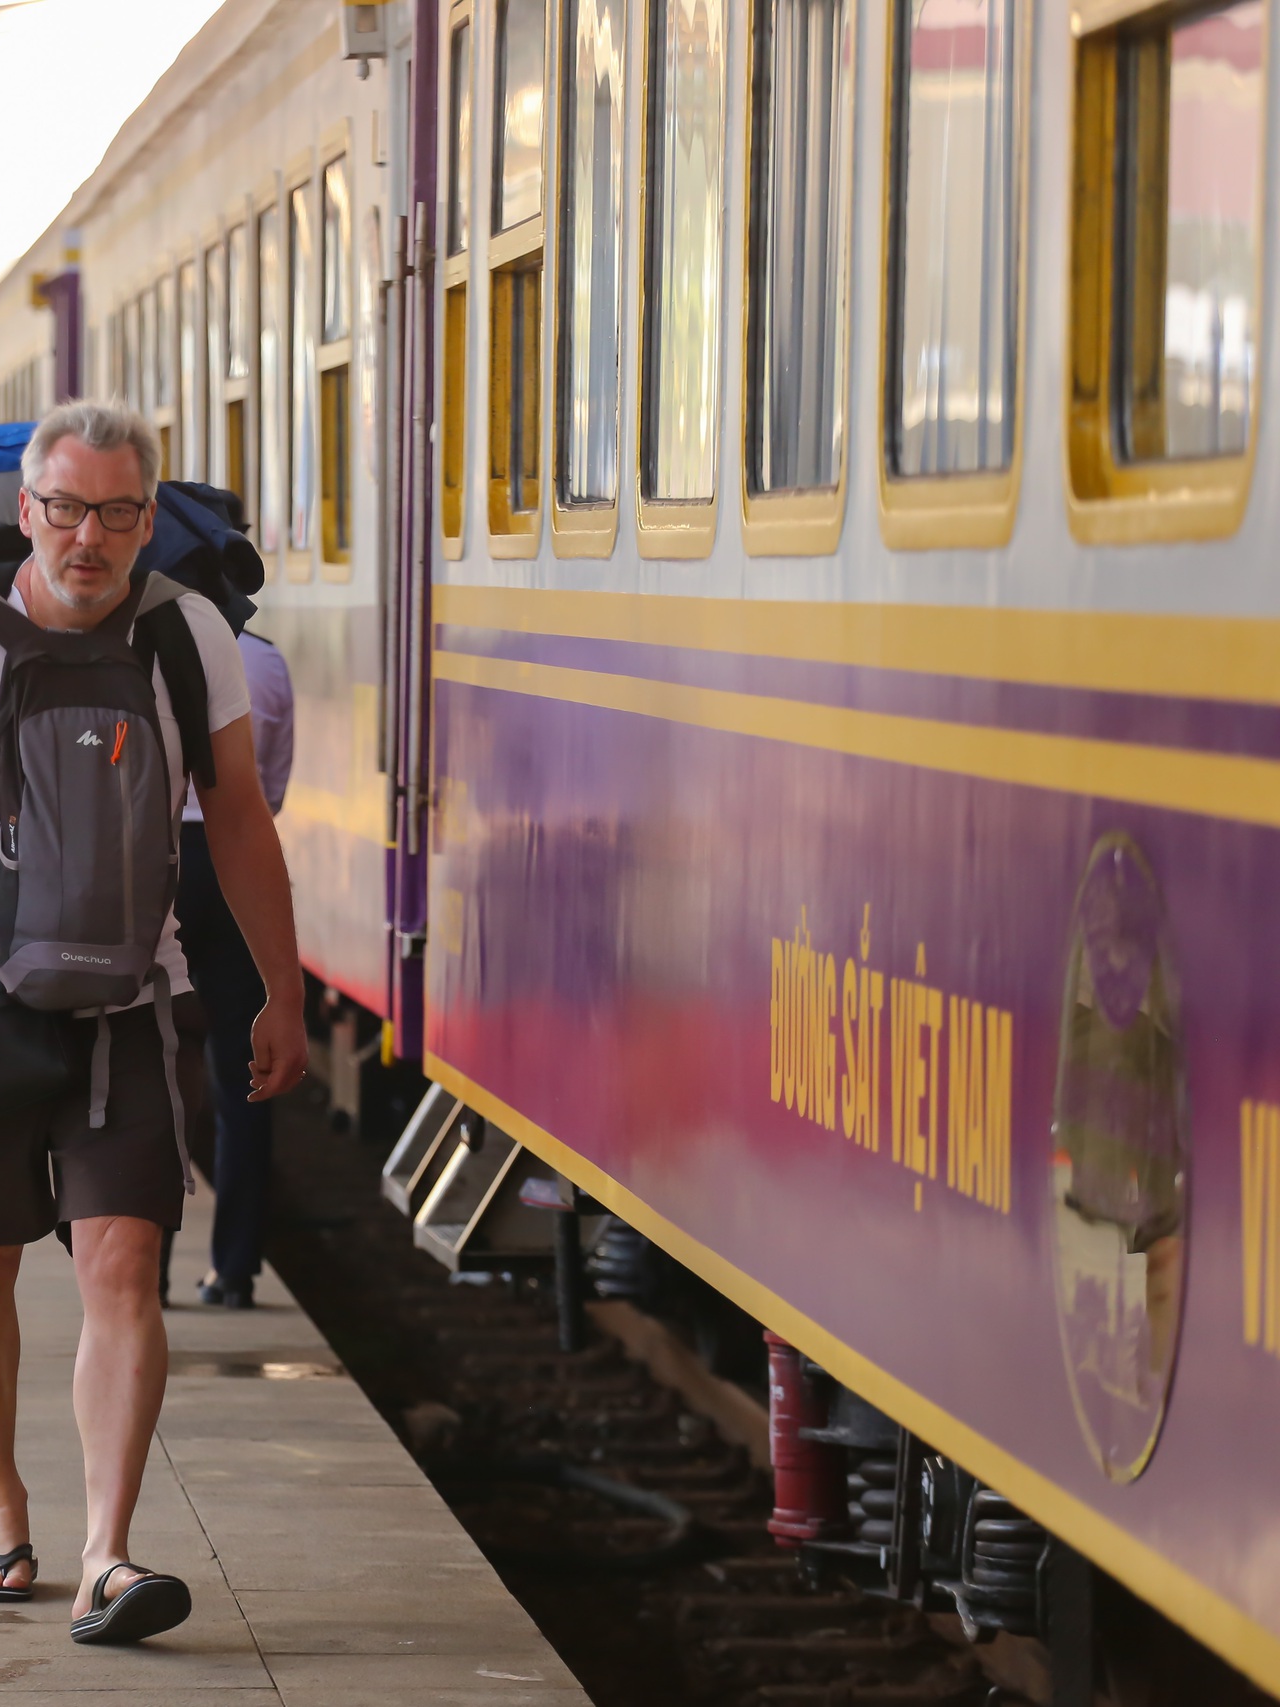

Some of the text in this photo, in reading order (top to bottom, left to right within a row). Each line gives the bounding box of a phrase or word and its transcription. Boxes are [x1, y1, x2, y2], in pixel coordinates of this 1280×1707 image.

[61, 952, 112, 965] Quechua
[770, 902, 1014, 1216] ĐƯỜNG SẮT VIỆT NAM
